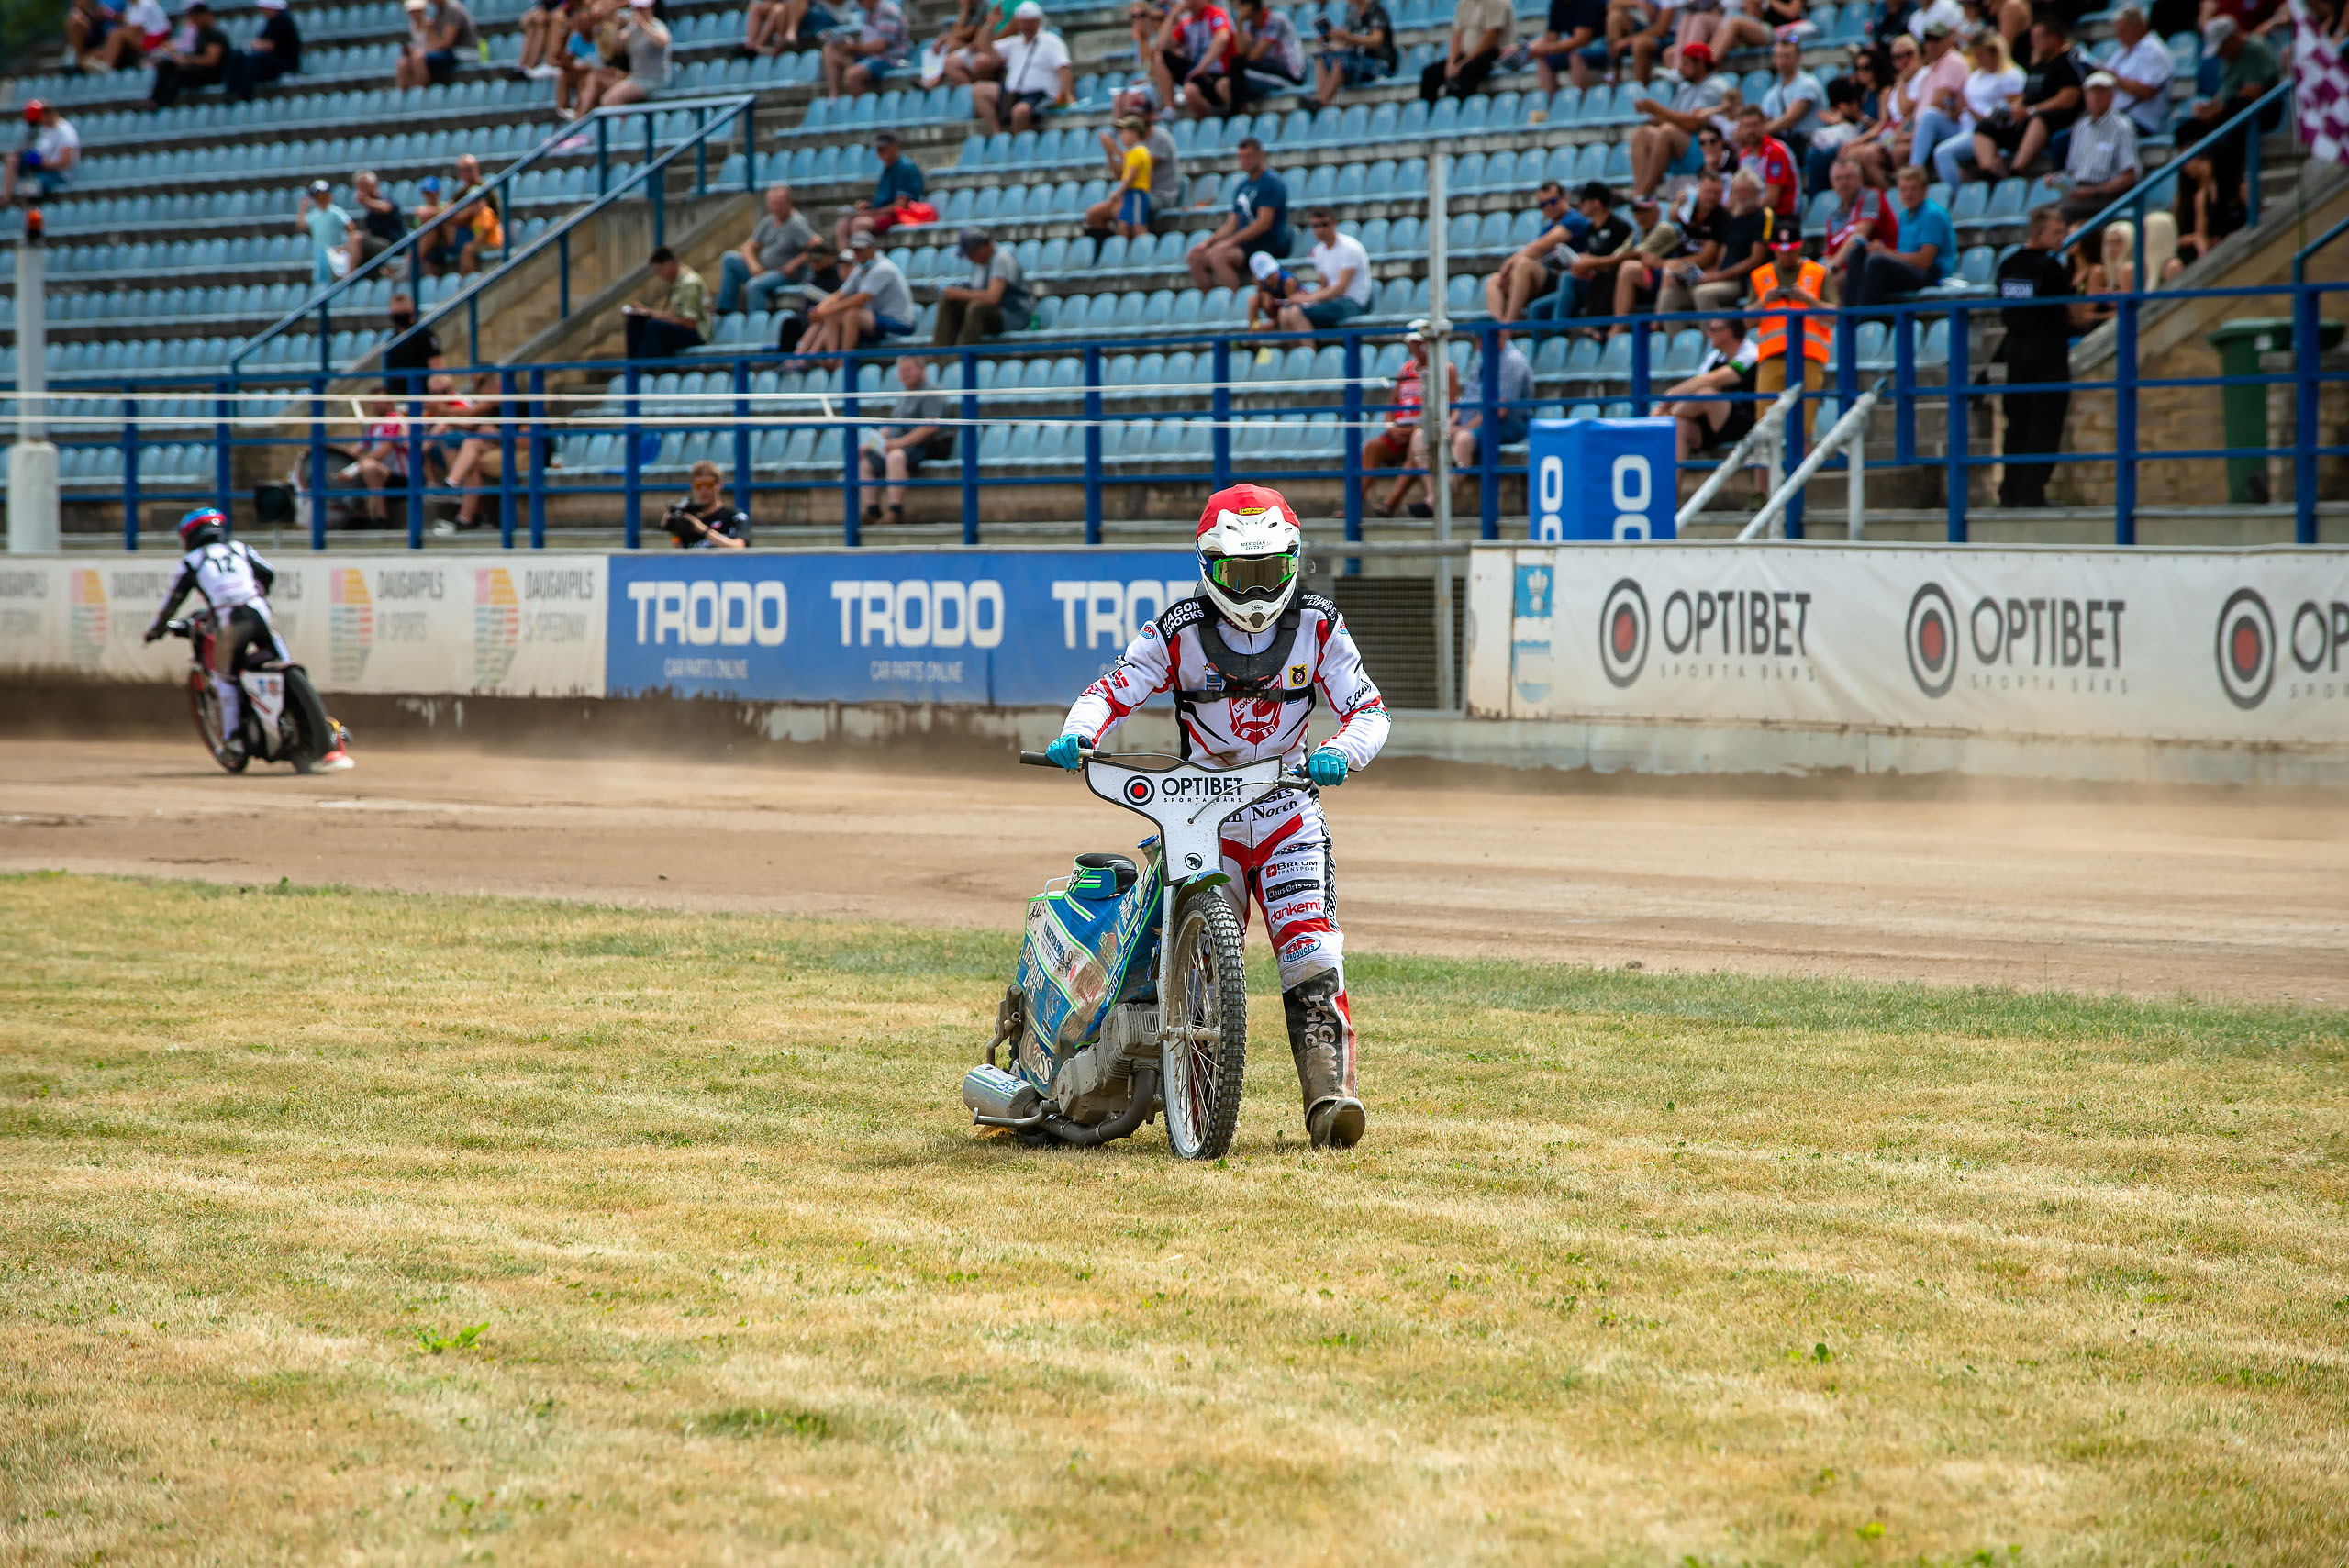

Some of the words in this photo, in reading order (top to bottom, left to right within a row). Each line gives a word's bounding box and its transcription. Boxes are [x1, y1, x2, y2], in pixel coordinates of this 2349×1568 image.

[377, 570, 444, 600] DAUGAVPILS
[525, 570, 595, 600] DAUGAVPILS
[628, 580, 788, 646] TRODO
[830, 579, 1006, 649] TRODO
[1052, 580, 1197, 650] TRO
[1162, 601, 1200, 631] HAGON
[1166, 609, 1205, 639] SHOCKS
[1663, 589, 1812, 657] OPTIBET
[1971, 595, 2125, 669] OPTIBET
[1660, 662, 1746, 680] SPORTA
[1971, 673, 2055, 690] SPORTA
[1161, 777, 1243, 796] OPTIBET
[1270, 898, 1322, 925] dankemi
[1286, 943, 1316, 962] PRODUCTS
